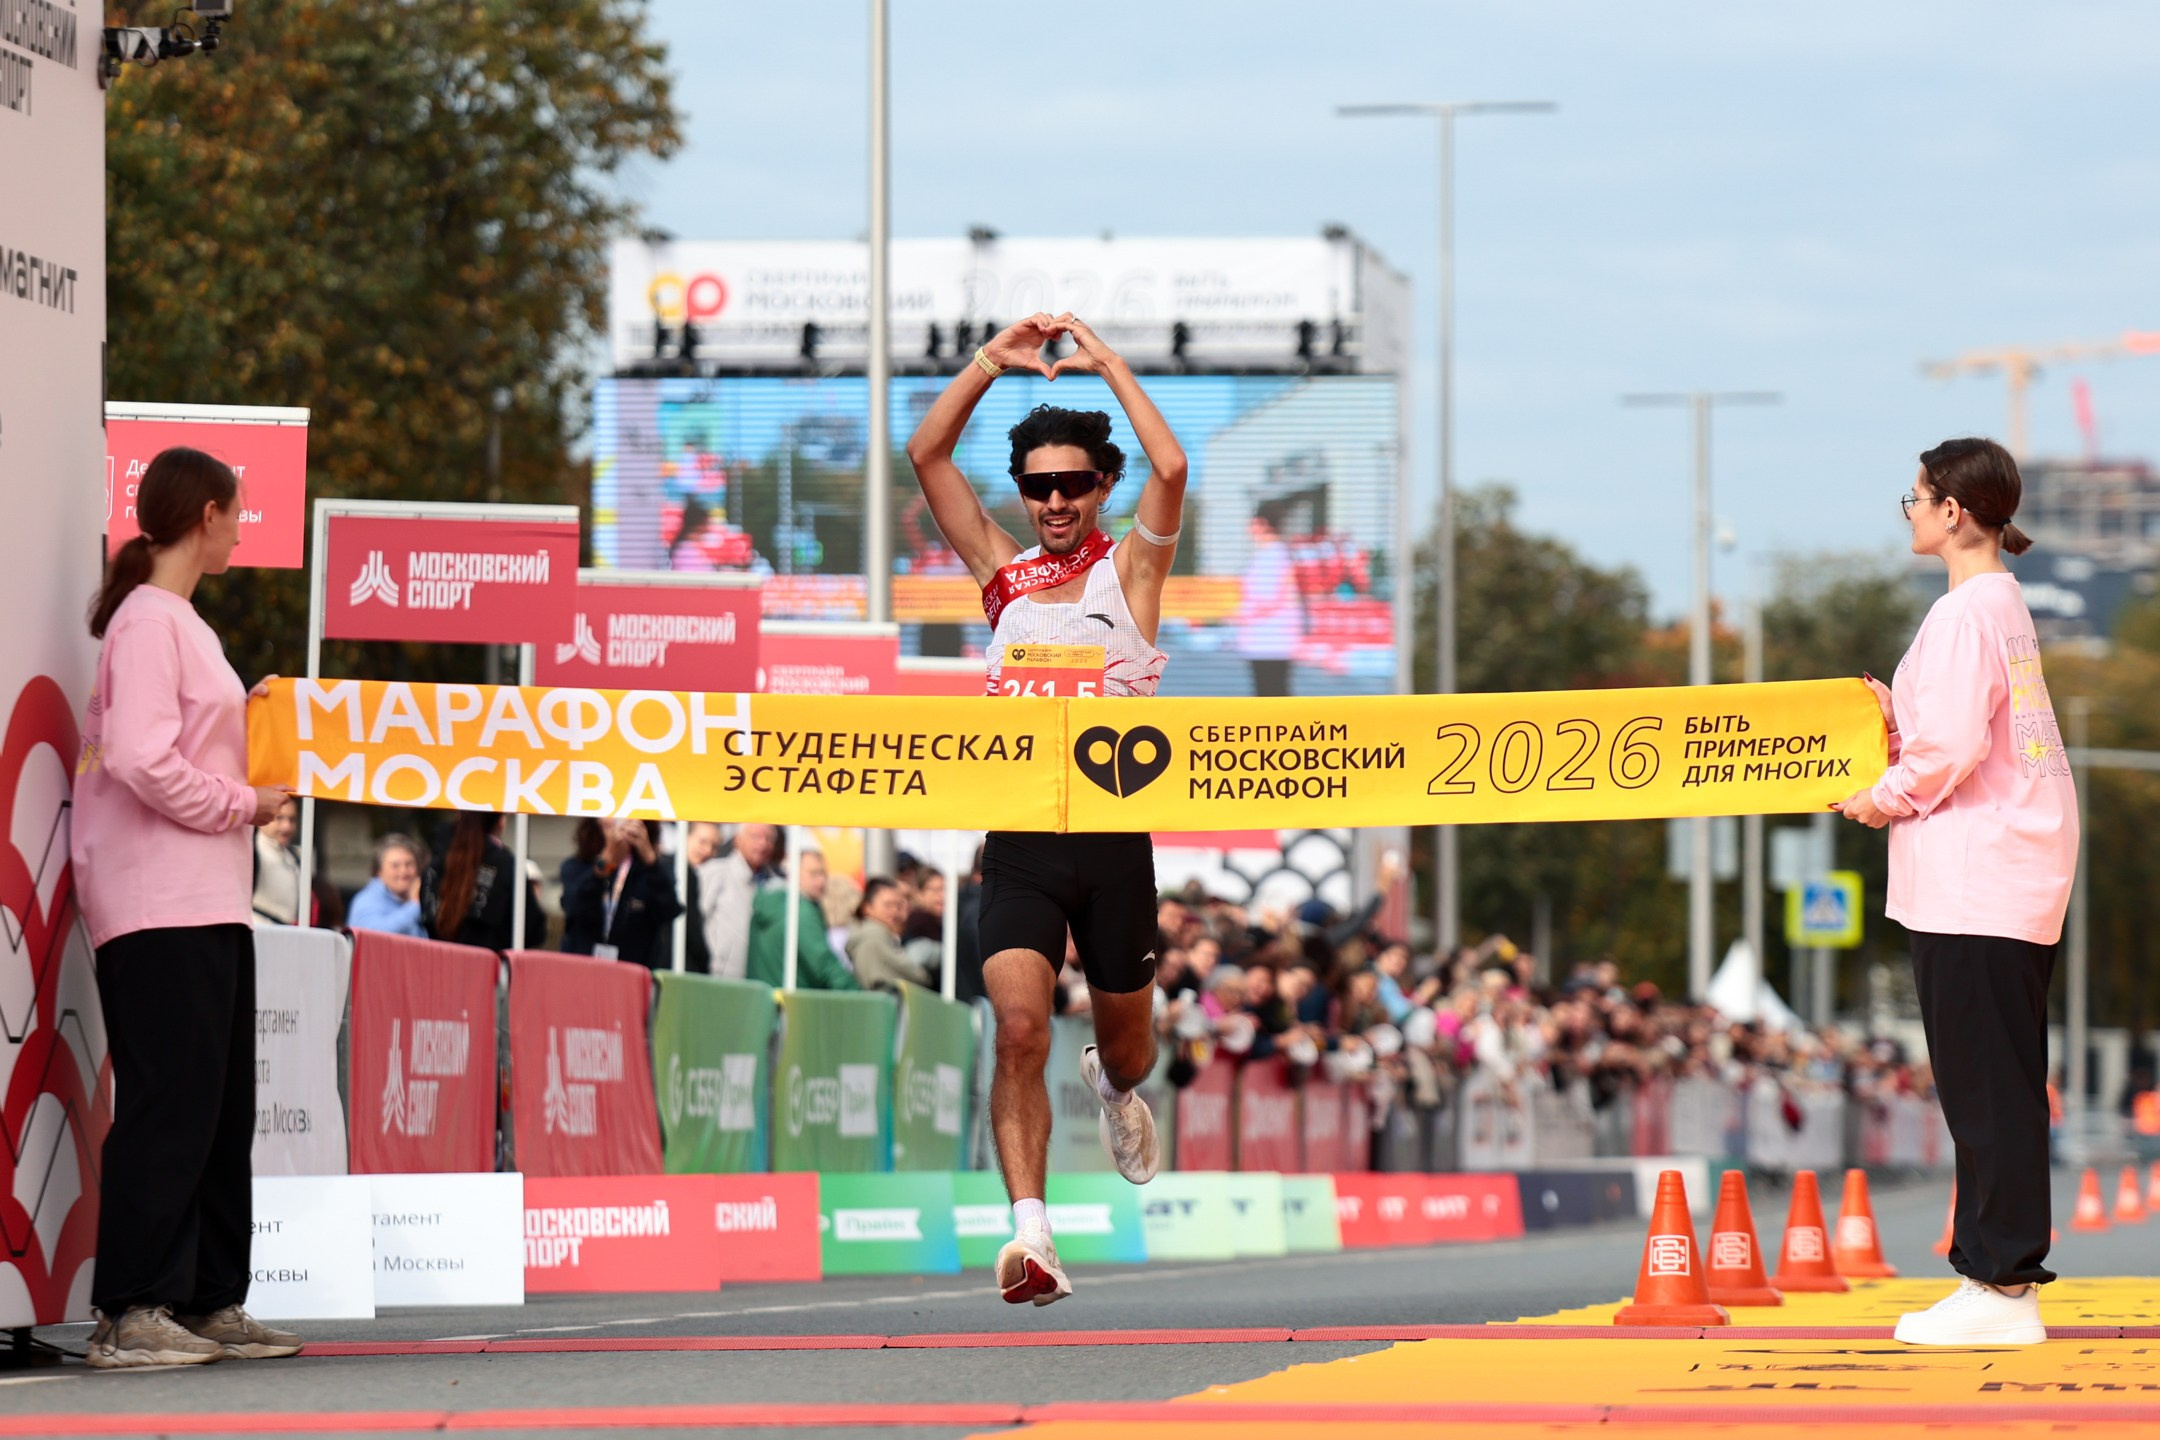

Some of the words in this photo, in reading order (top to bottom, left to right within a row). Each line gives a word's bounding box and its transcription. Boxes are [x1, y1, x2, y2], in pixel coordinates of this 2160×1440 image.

[408, 549, 550, 584] МОСКОВСКИЙ
[407, 580, 475, 610] СПОРТ
[608, 611, 737, 645] МОСКОВСКИЙ
[606, 639, 670, 668] СПОРТ
[294, 678, 753, 755] МАРАФОН
[1189, 720, 1348, 743] СБЕРПРАЙМ
[1684, 714, 1751, 735] БЫТЬ
[724, 729, 1035, 764] СТУДЕНЧЕСКАЯ
[1189, 742, 1405, 772] МОСКОВСКИЙ
[1427, 716, 1663, 795] 2026
[1684, 734, 1827, 760] ПРИМЕРОМ
[298, 750, 677, 819] МОСКВА
[724, 764, 928, 796] ЭСТАФЕТА
[1189, 776, 1347, 800] МАРАФОН
[1681, 761, 1734, 788] ДЛЯ
[1743, 757, 1852, 783] МНОГИХ
[524, 1199, 670, 1237] ОСКОВСКИЙ
[384, 1256, 465, 1272] Москвы
